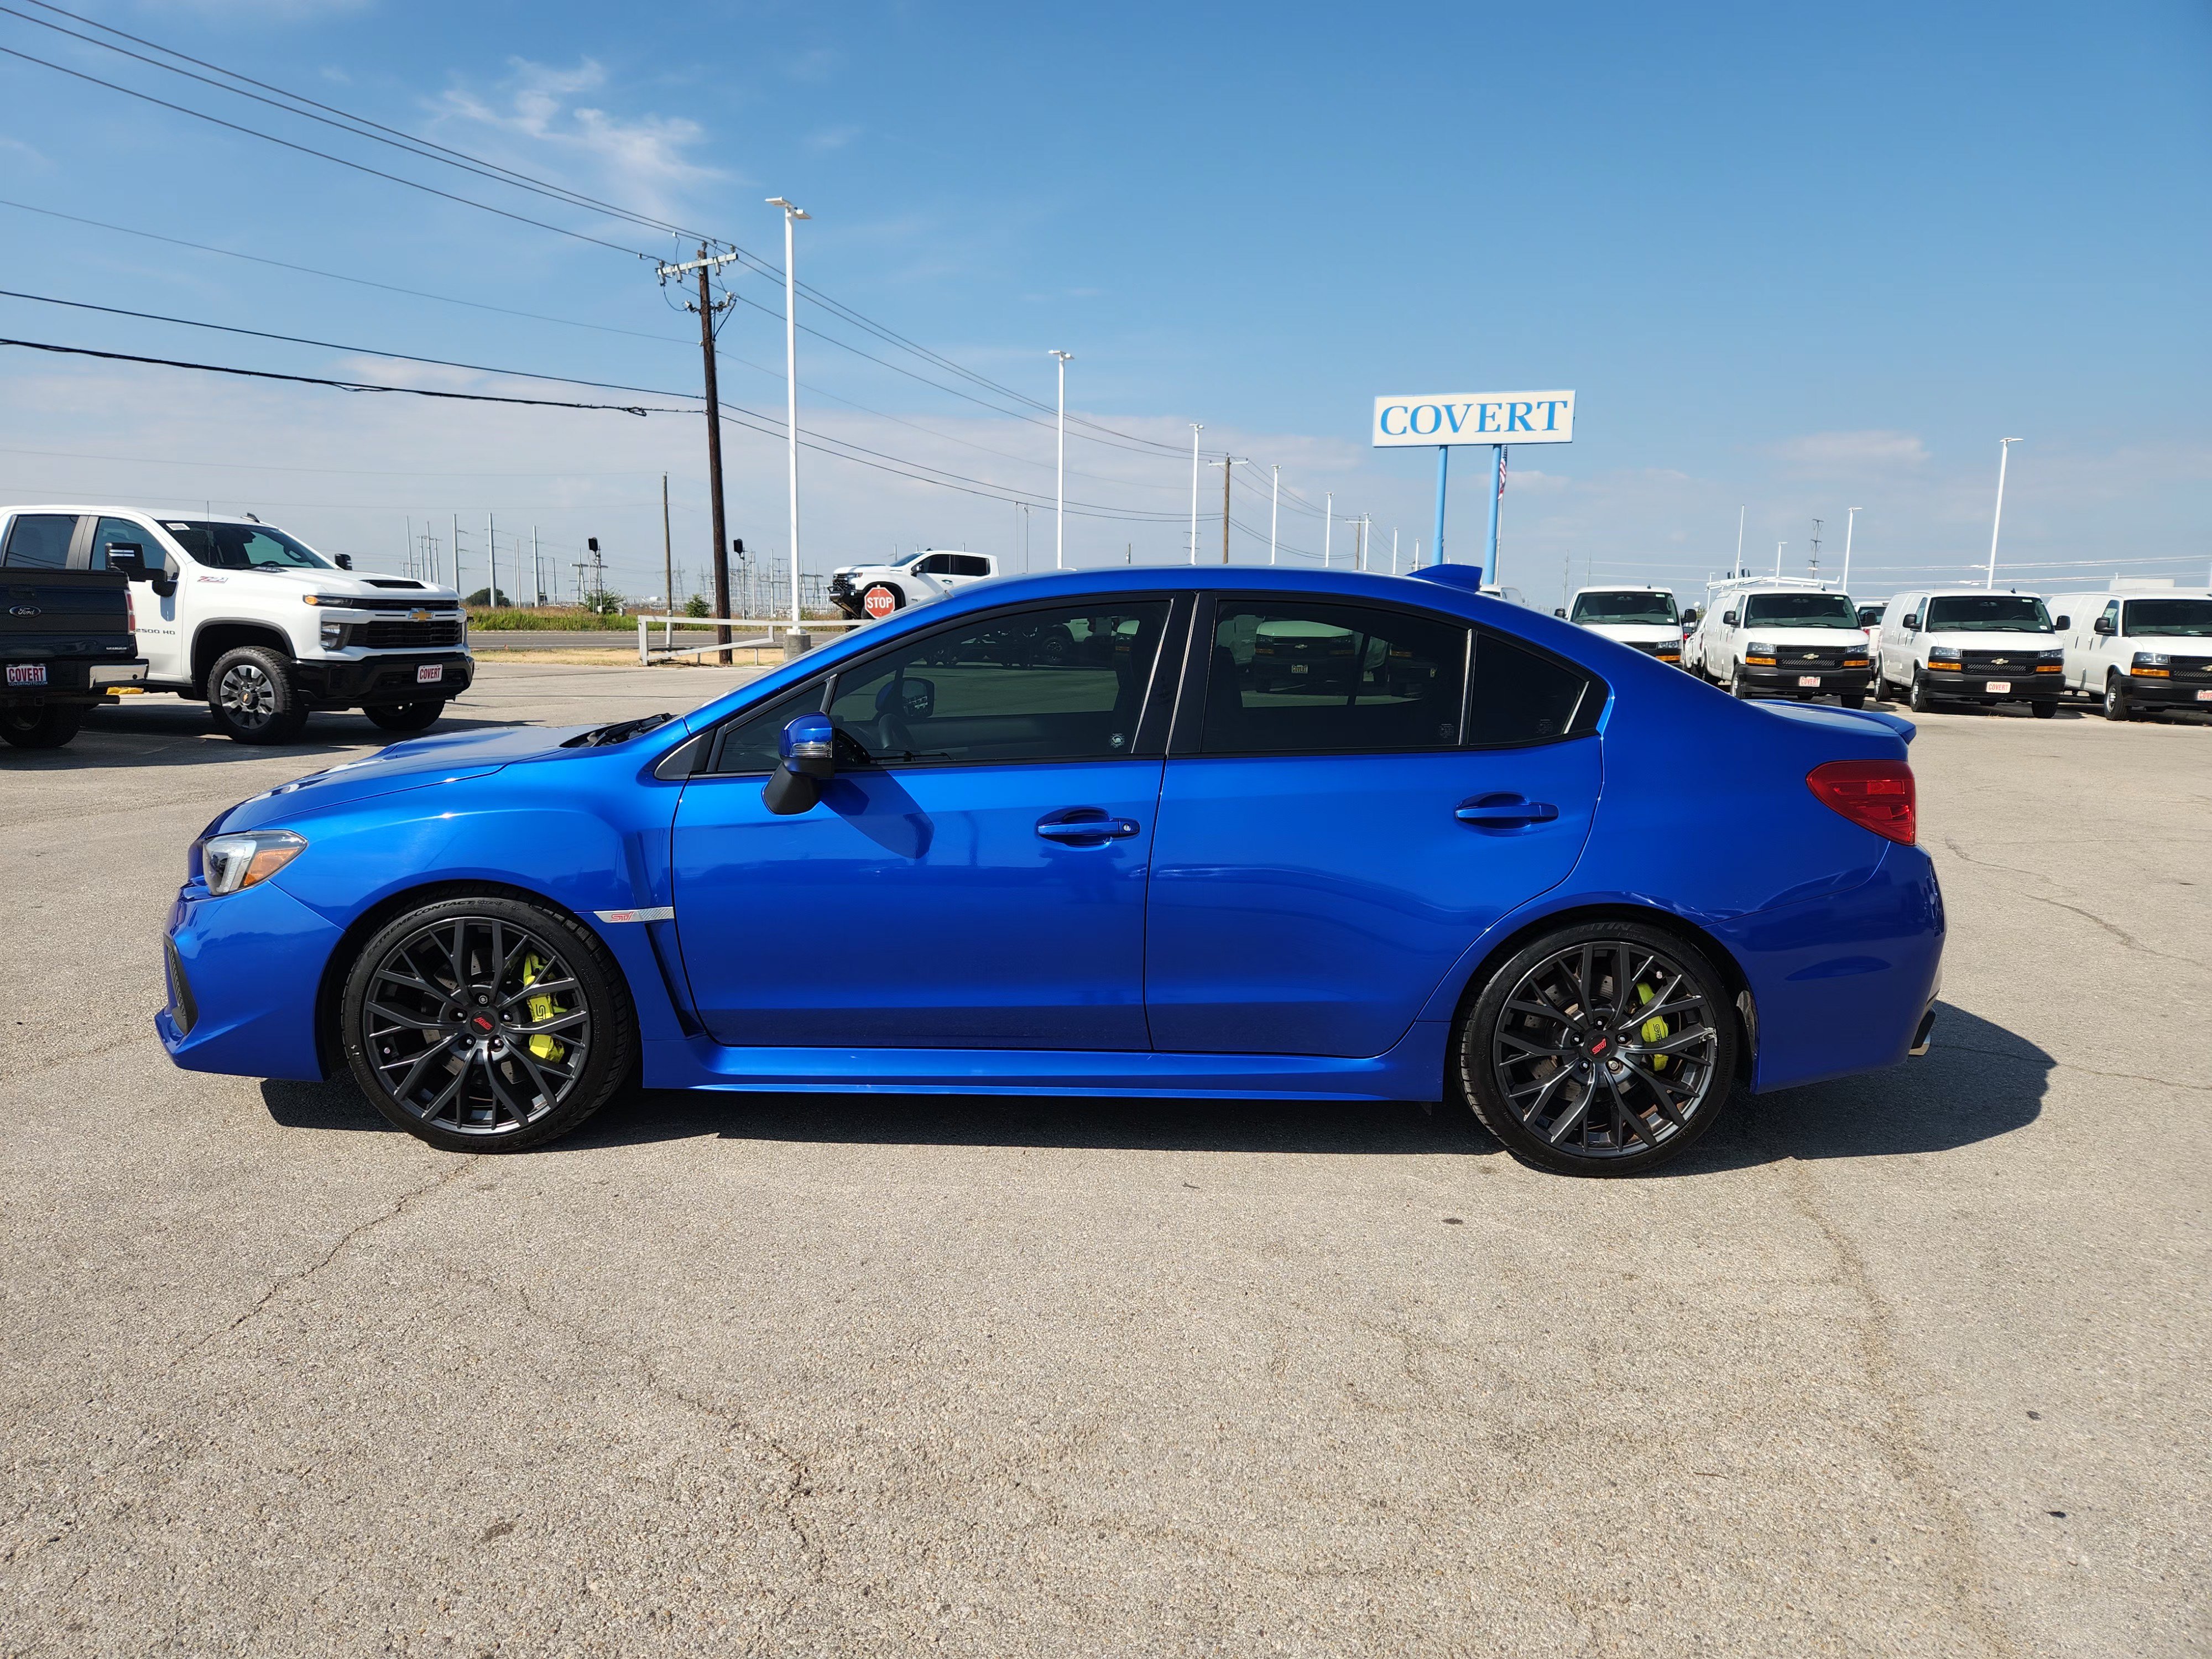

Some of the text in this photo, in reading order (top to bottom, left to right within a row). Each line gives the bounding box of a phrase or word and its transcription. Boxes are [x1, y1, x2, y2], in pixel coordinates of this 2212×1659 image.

[1380, 400, 1568, 436] COVERT
[867, 597, 893, 609] STOP
[9, 667, 44, 681] COVERT
[419, 667, 441, 680] COVERT
[611, 911, 634, 922] STI
[473, 1017, 494, 1030] STI
[1592, 1037, 1606, 1055] STI
